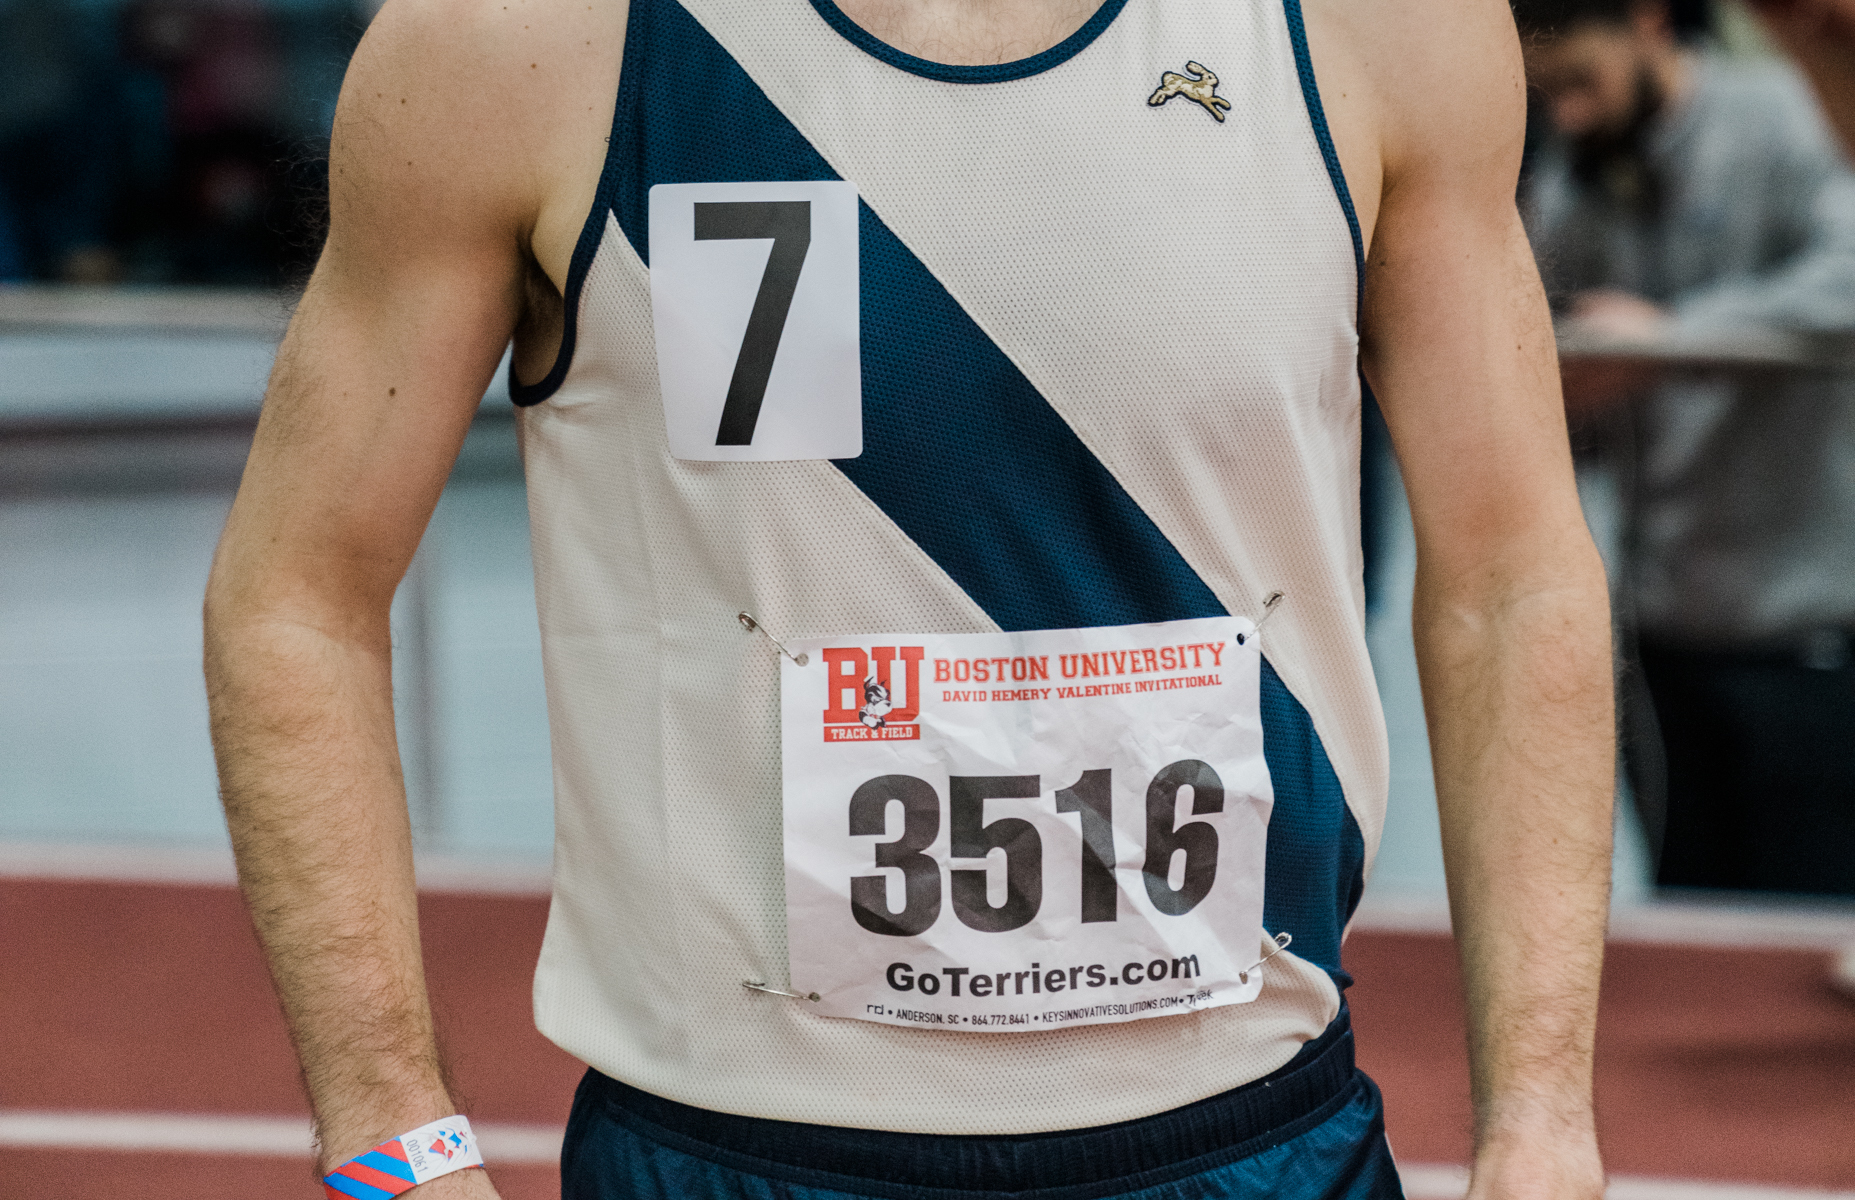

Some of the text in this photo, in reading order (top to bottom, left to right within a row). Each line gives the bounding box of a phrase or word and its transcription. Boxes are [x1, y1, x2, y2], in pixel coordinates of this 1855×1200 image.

[694, 201, 811, 446] 7
[933, 641, 1226, 683] BOSTON UNIVERSITY
[822, 646, 925, 724] BU
[942, 674, 1223, 702] DAVID HEMERY VALENTINE INVITATIONAL
[831, 728, 868, 740] TRACK
[882, 727, 913, 739] FIELD
[848, 758, 1226, 937] 3516
[886, 953, 1201, 997] GoTerriers.com
[947, 1014, 960, 1025] SC
[971, 1013, 1029, 1026] 864.772.8441
[1042, 996, 1178, 1023] KEYSINNOVATIVESOLUTIONS.COM
